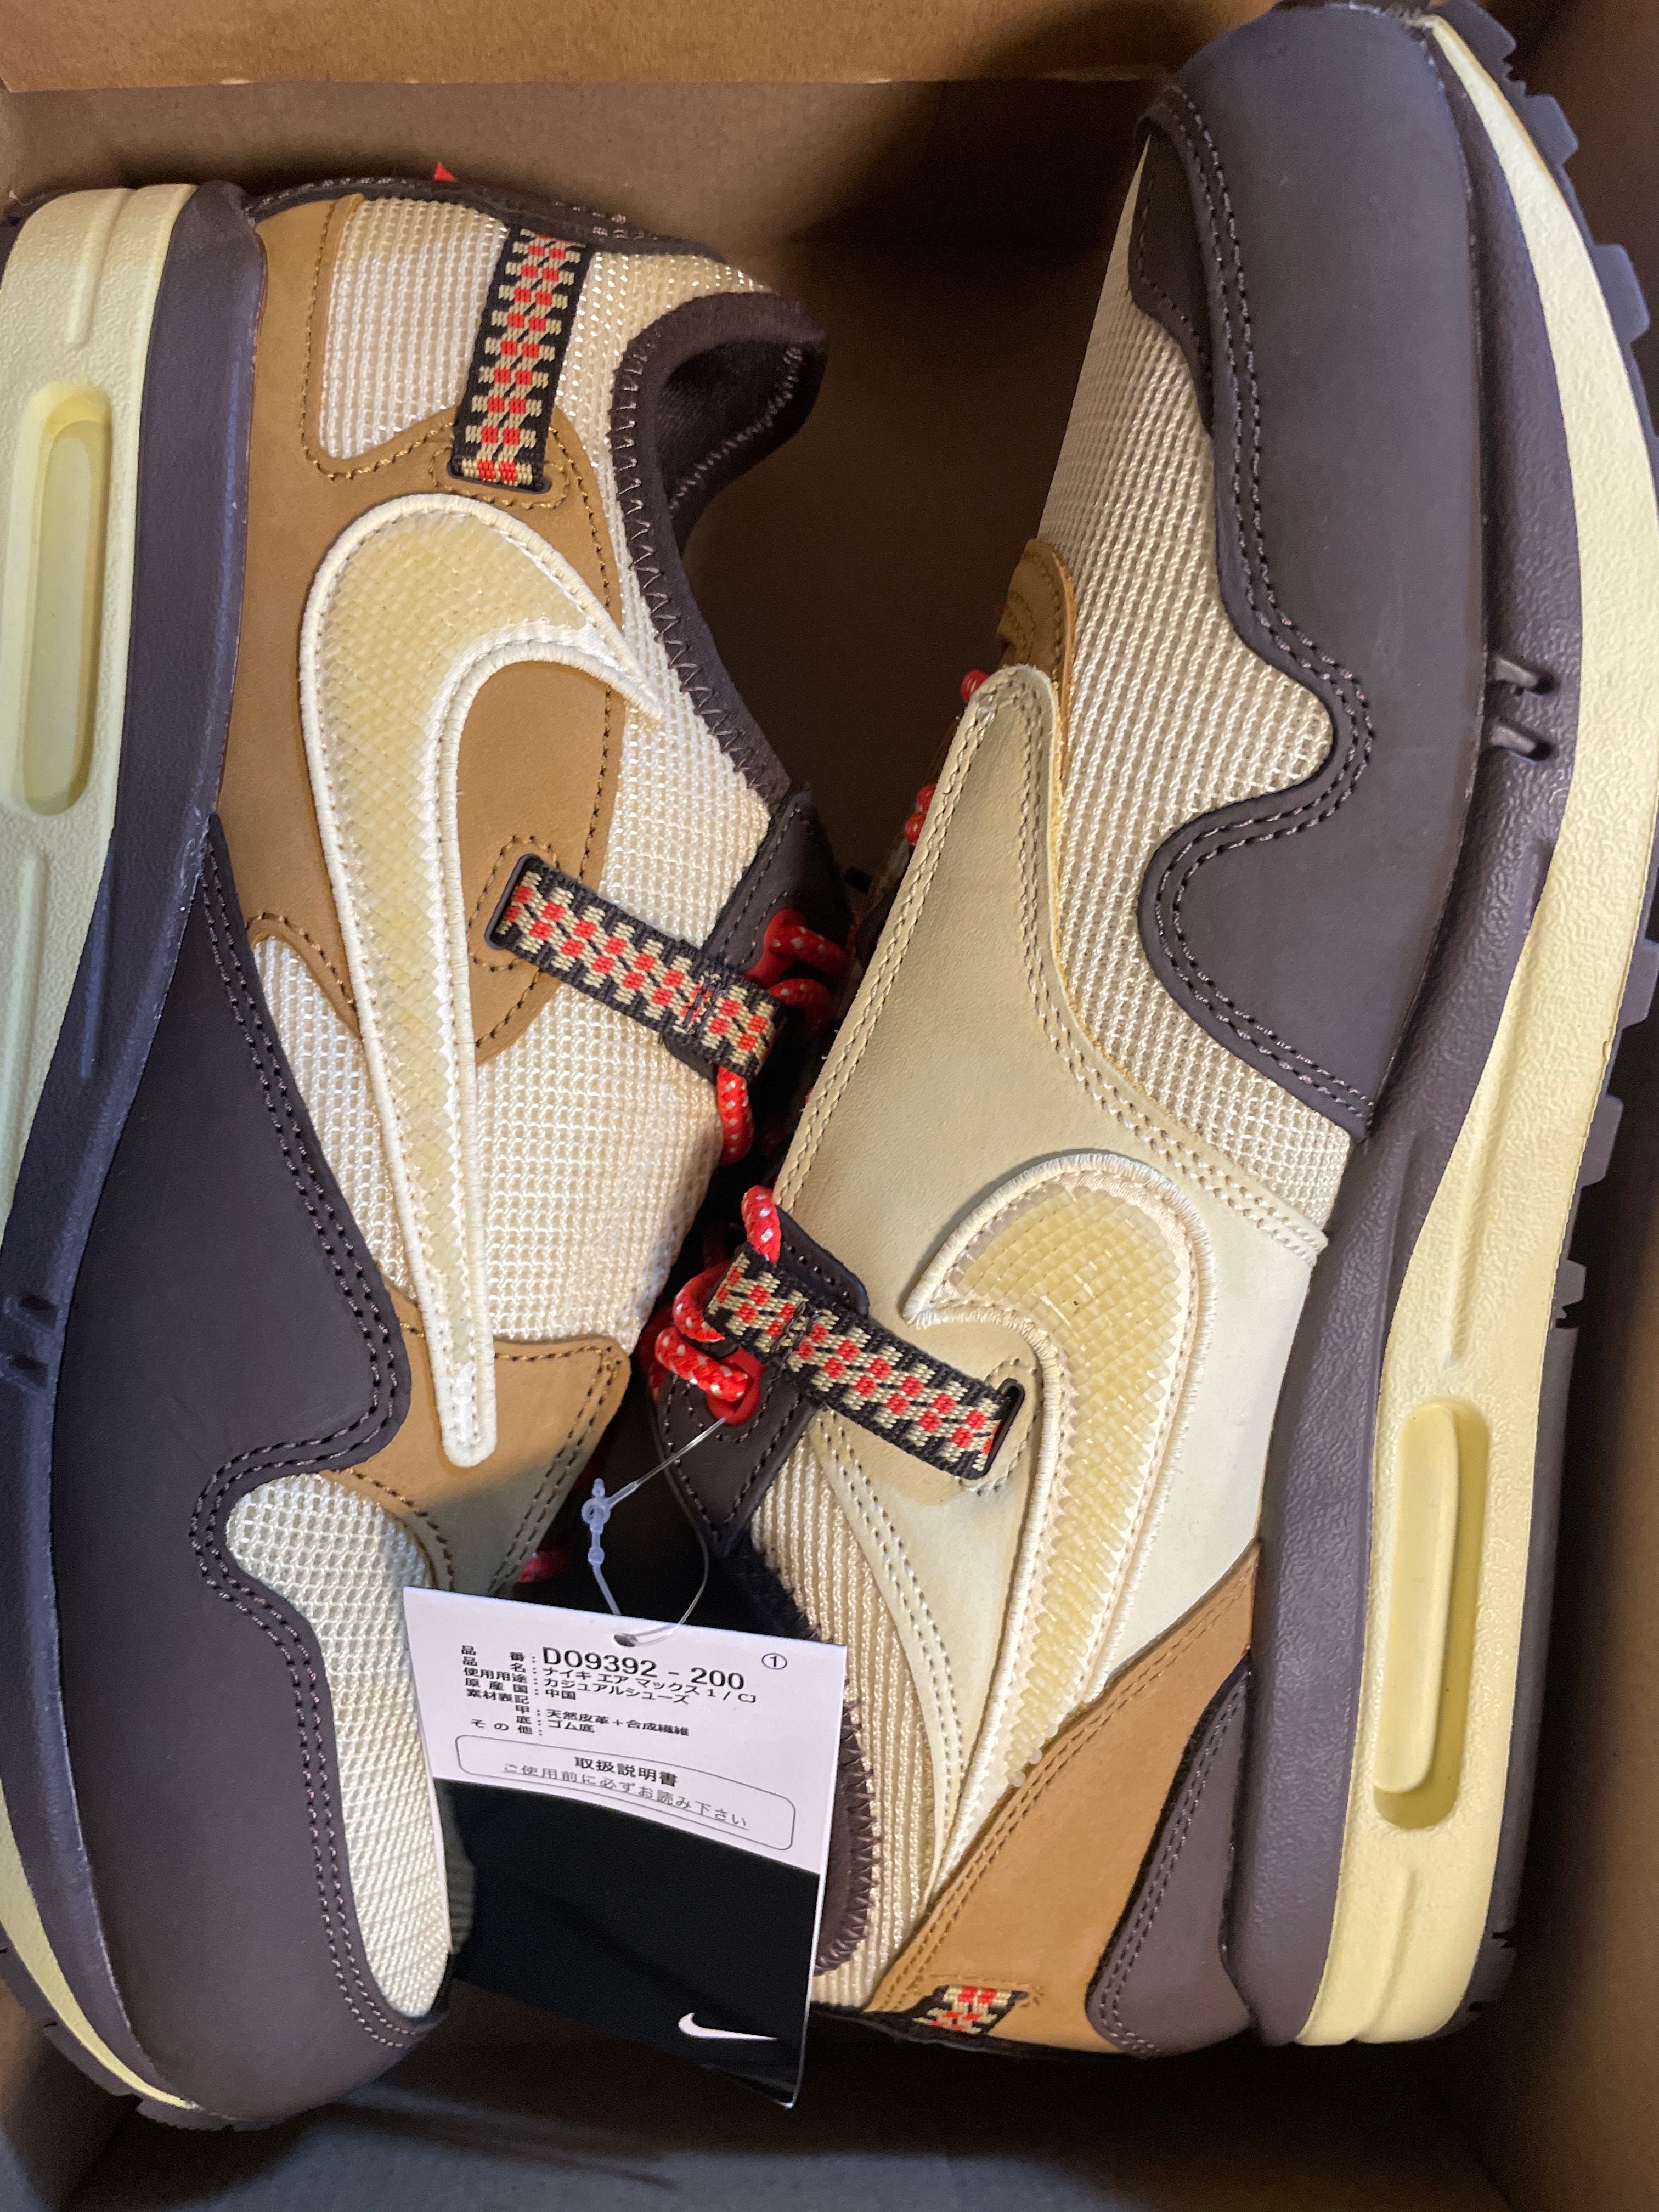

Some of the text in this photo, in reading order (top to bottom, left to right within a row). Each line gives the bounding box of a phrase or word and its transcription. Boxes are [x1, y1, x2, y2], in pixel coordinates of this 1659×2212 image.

[543, 1667, 591, 1680] ナイキ
[597, 1673, 629, 1684] エア
[635, 1678, 700, 1695] マックス
[544, 1678, 689, 1705] カジュアルシューズ
[466, 1688, 529, 1705] 素材表記
[545, 1689, 576, 1701] 中国
[548, 1719, 595, 1733] ゴム底
[575, 1756, 678, 1787] 取扱説明書
[504, 1762, 747, 1827] ご使用前に必ずお読み下さい
